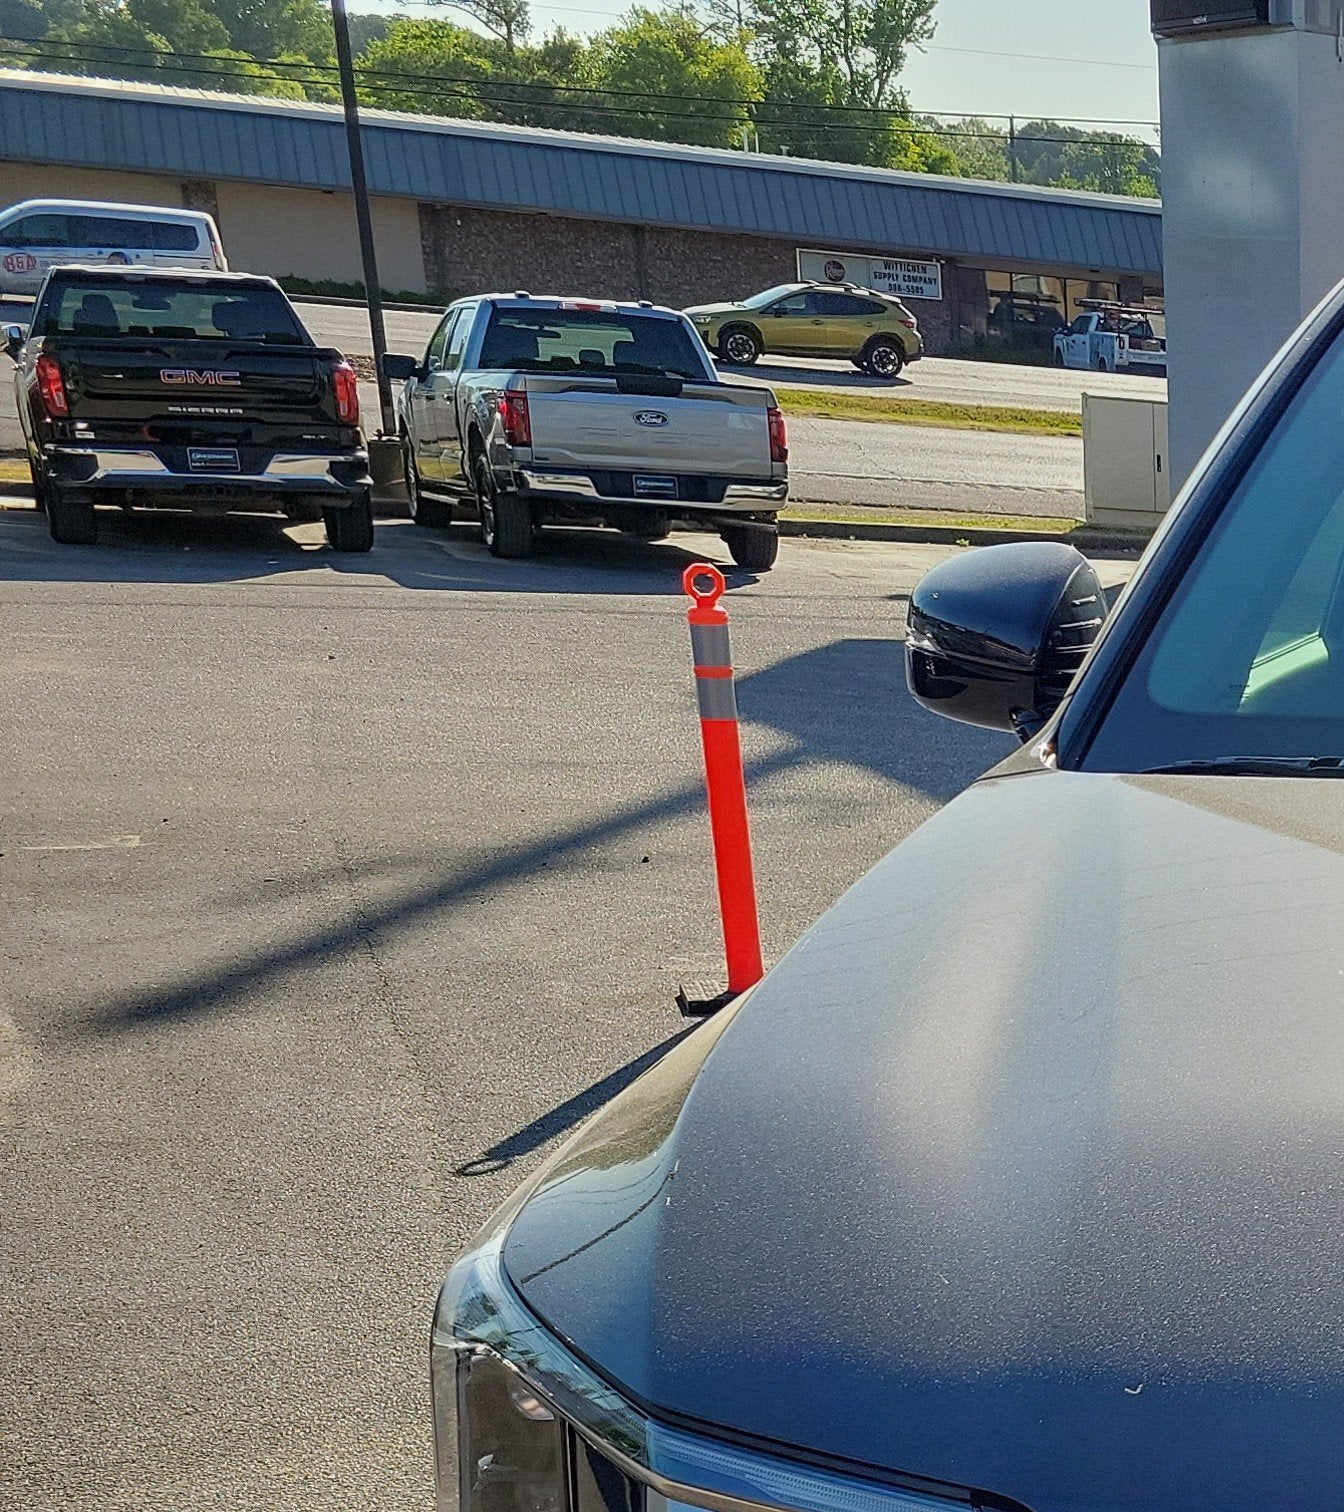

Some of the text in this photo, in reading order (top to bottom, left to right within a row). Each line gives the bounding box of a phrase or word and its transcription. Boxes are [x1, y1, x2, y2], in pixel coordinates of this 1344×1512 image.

[873, 271, 938, 285] SUPPLY COMPANY
[160, 369, 241, 385] GMC
[168, 406, 244, 414] SIERRA
